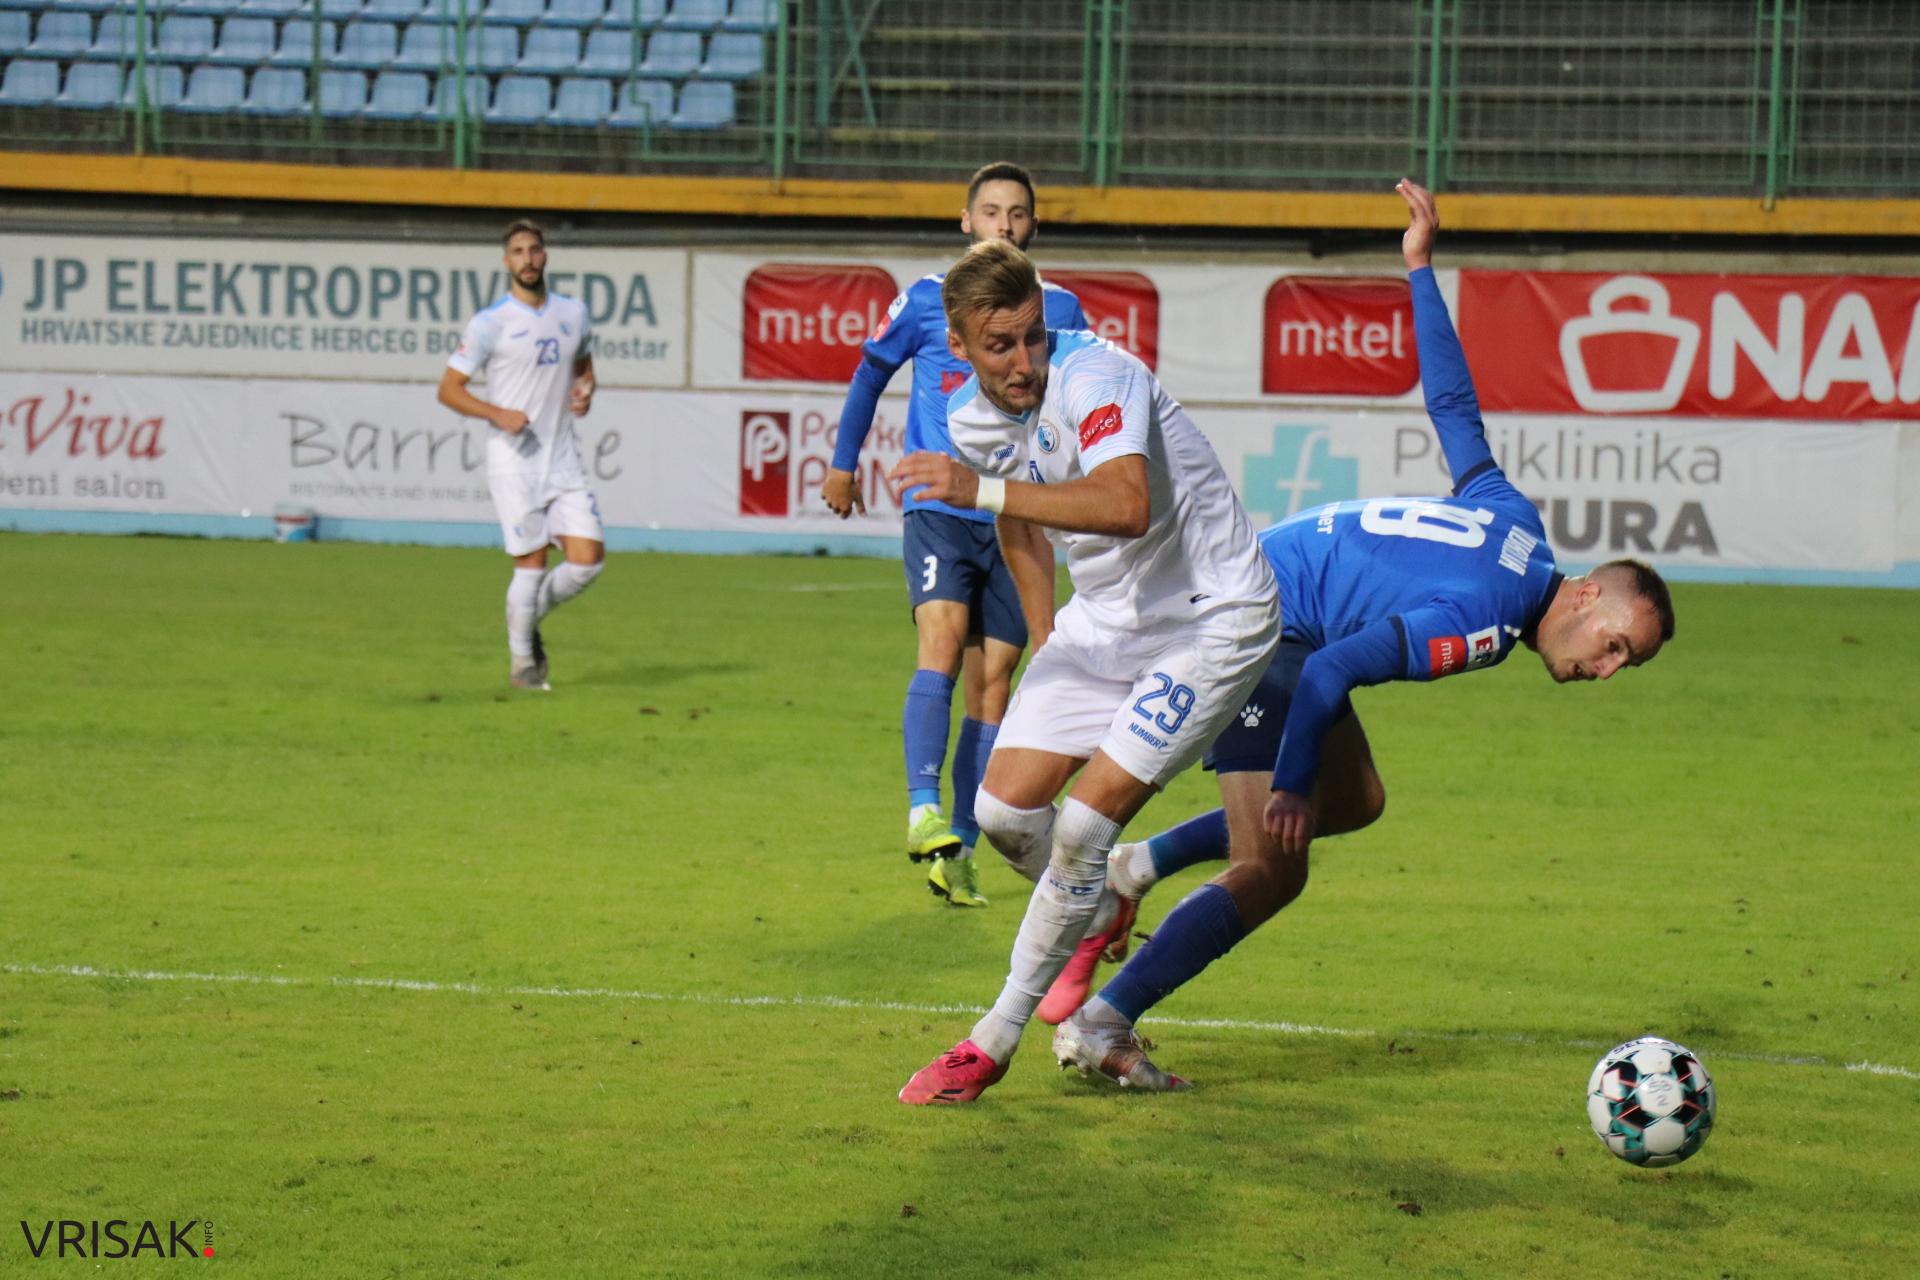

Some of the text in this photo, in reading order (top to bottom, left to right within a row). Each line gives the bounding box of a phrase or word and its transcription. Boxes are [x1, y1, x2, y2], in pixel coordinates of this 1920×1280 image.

[24, 258, 657, 327] JP ELEKTROPRIVDA
[21, 318, 155, 346] HRVATSKE
[163, 321, 302, 350] ZAJEDNICE
[311, 327, 417, 353] HERCEG
[759, 299, 877, 346] m:tel
[1279, 309, 1405, 358] m:tel
[535, 338, 560, 365] 23
[1393, 426, 1722, 484] Piklinika
[73, 473, 165, 500] salon
[921, 555, 938, 592] 3
[1132, 672, 1196, 735] 29
